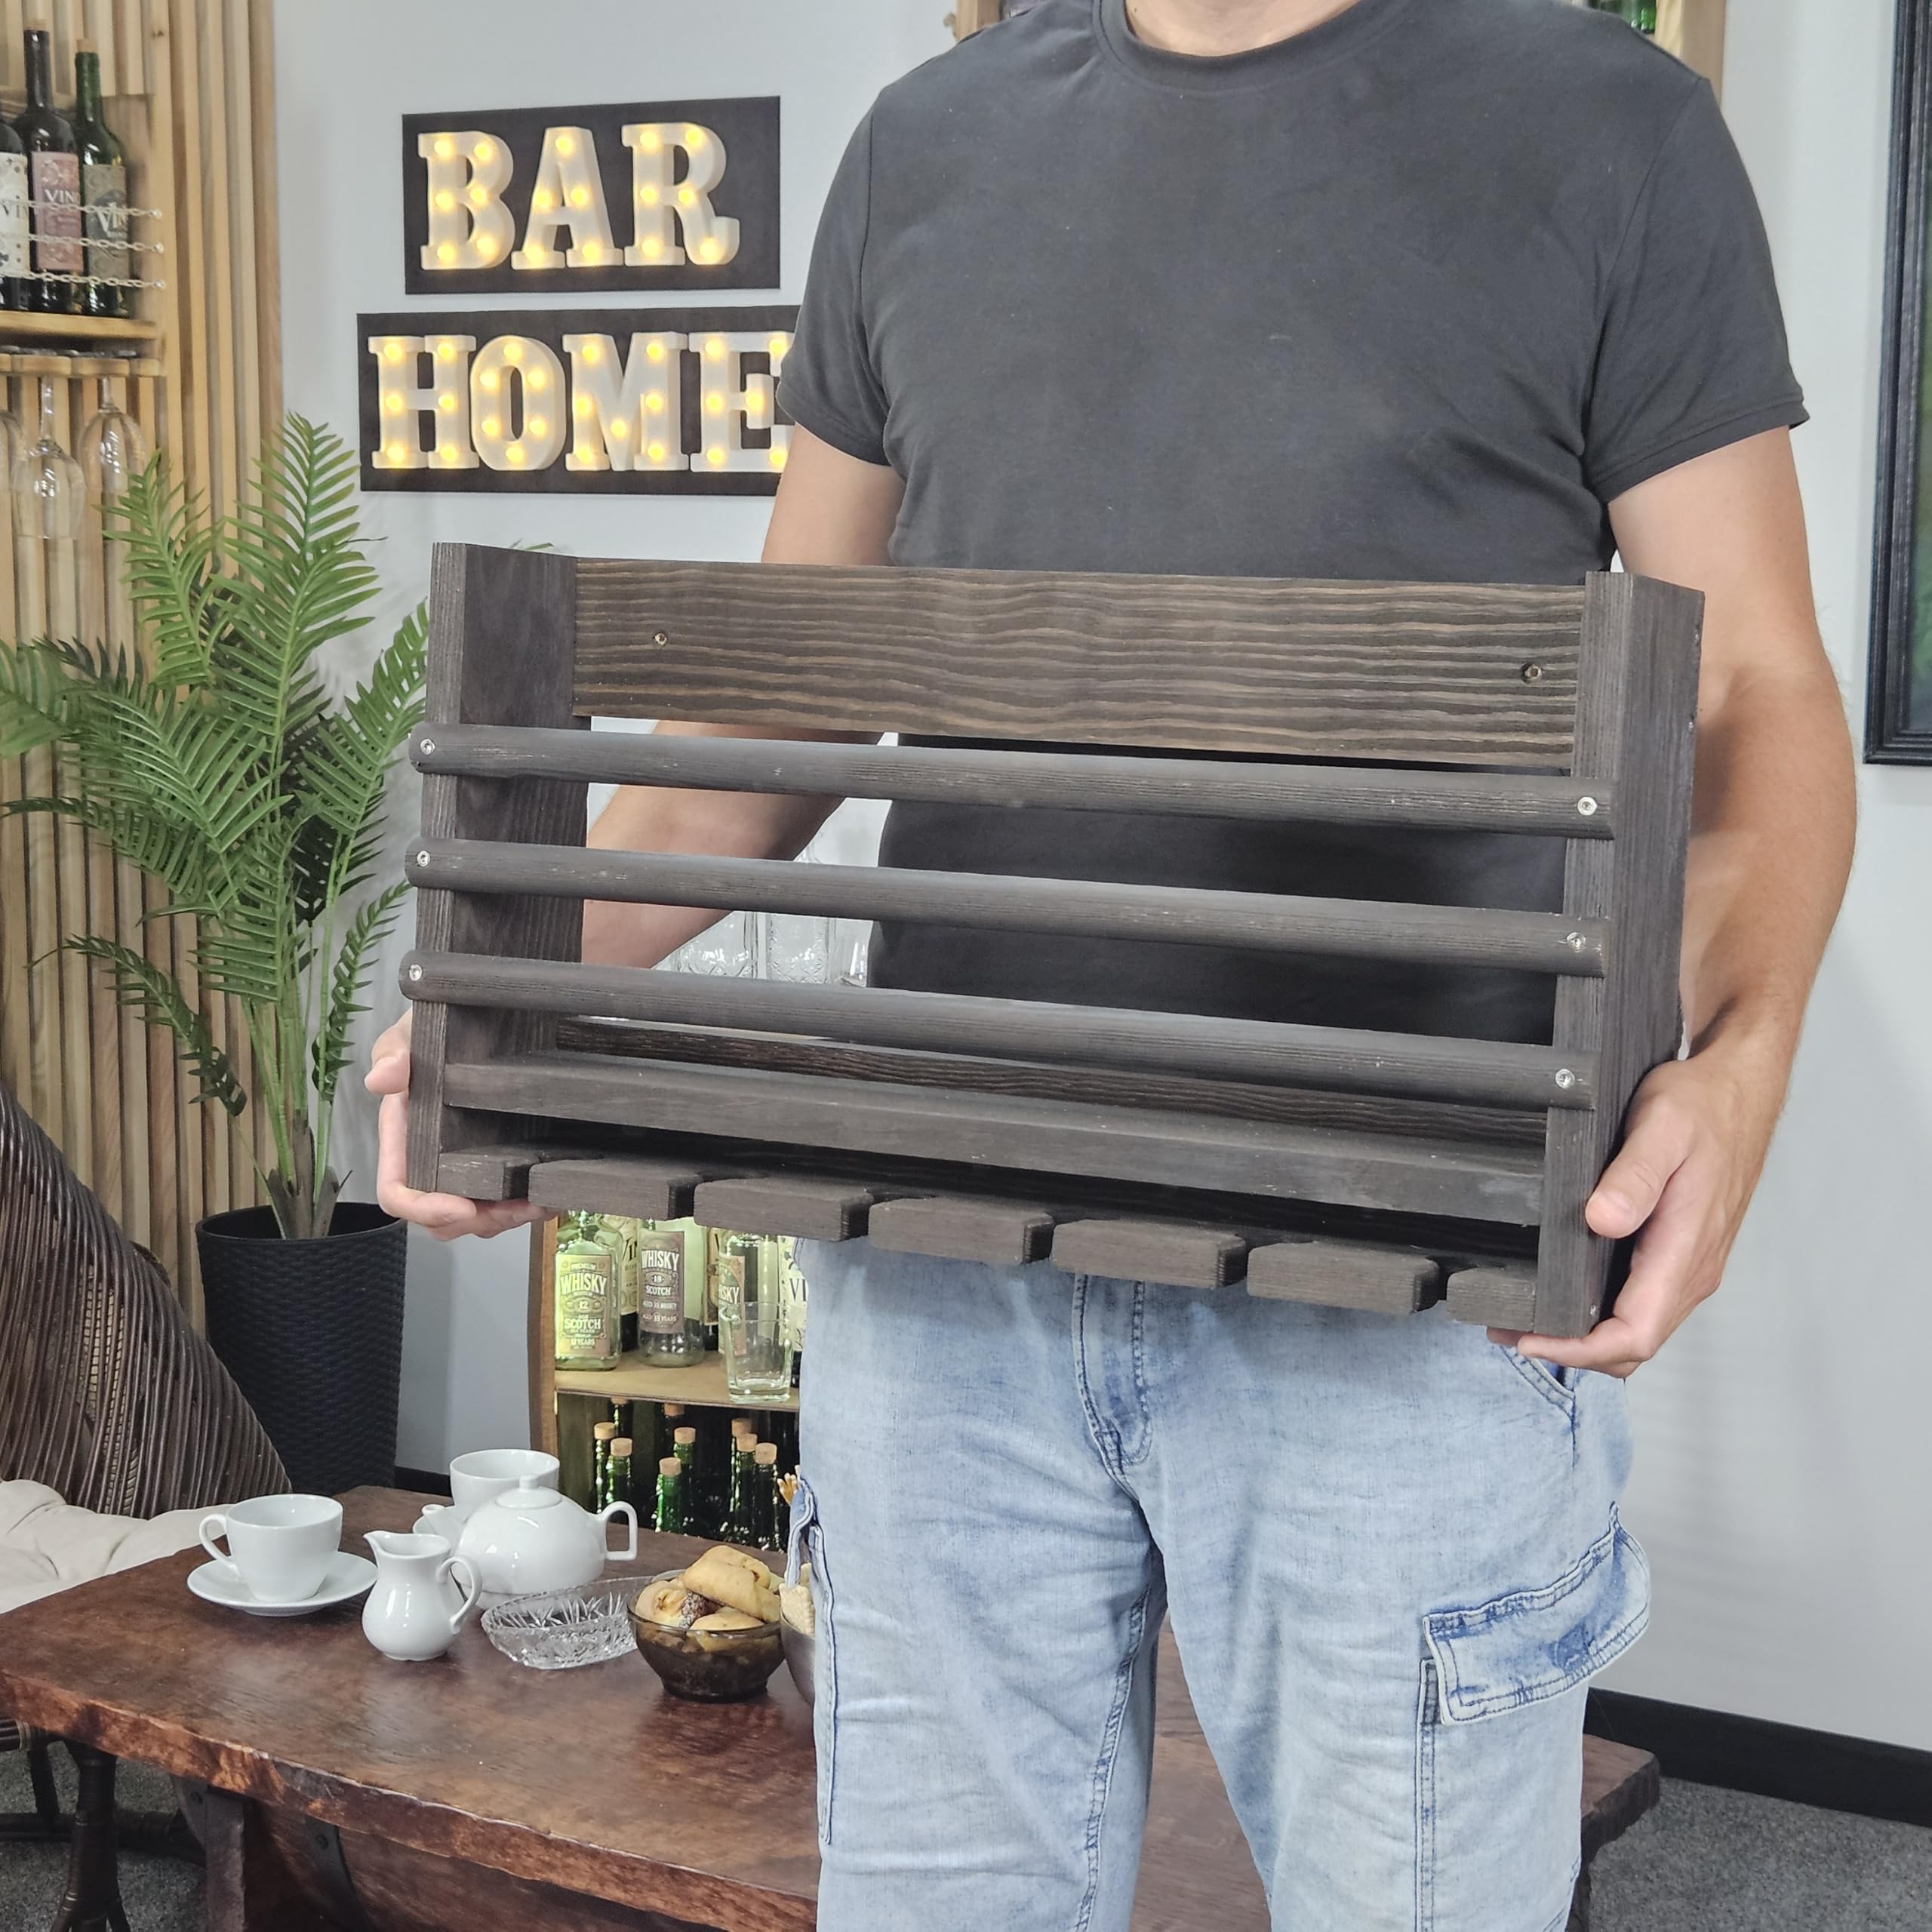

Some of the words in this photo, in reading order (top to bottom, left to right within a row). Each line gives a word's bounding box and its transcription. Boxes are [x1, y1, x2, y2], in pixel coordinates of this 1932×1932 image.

[417, 122, 740, 270] BAR
[368, 331, 795, 472] HOME
[641, 1250, 680, 1271] WHISKY
[560, 1272, 607, 1295] WHISKY
[645, 1284, 672, 1296] SCOTCH
[579, 1300, 589, 1309] 12
[564, 1318, 601, 1330] SCOTCH
